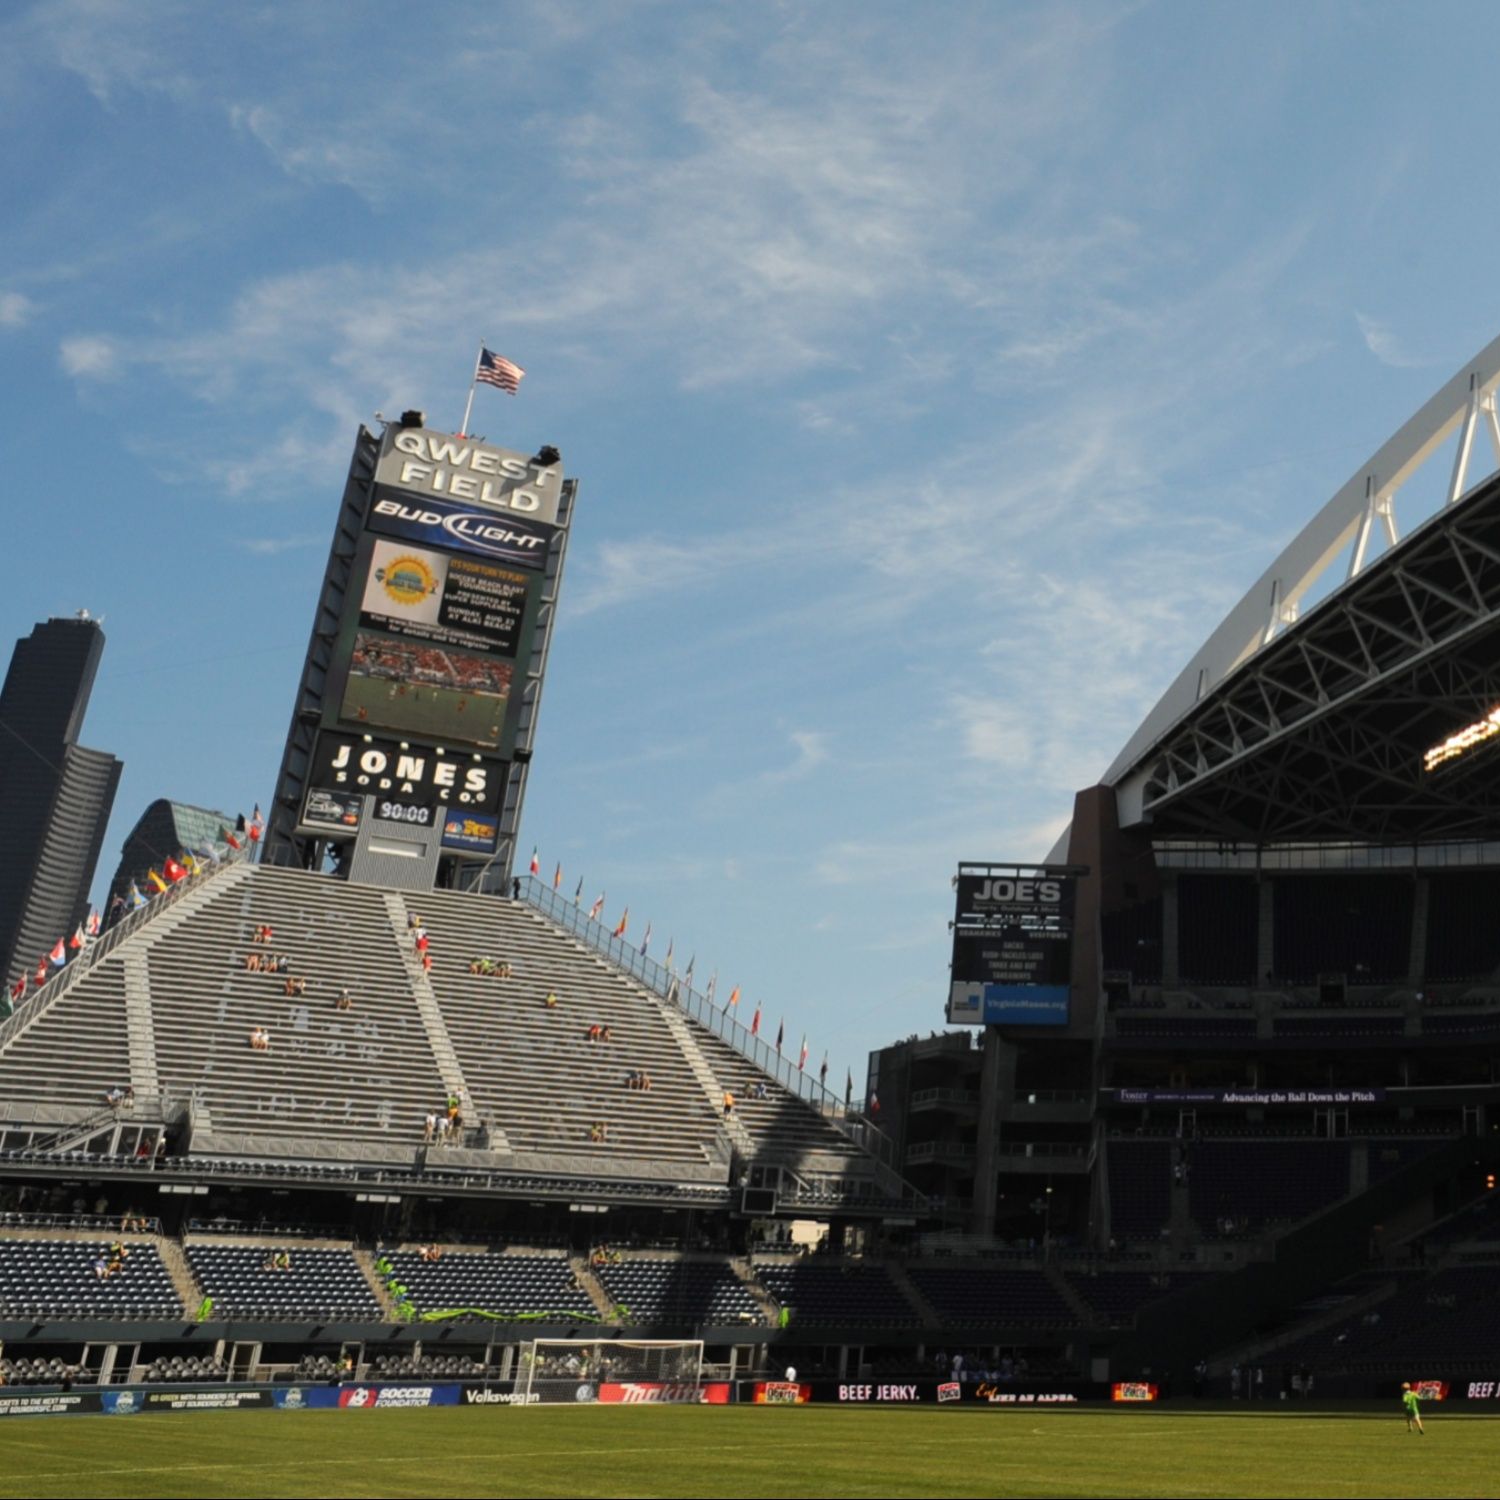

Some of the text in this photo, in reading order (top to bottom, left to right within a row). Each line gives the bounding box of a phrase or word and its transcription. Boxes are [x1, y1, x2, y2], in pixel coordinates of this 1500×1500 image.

[394, 432, 557, 487] QWEST
[400, 461, 540, 512] FIELD
[374, 500, 545, 549] BUD LIGHT
[331, 745, 487, 791] JONES
[336, 771, 413, 793] SODA
[380, 802, 429, 823] 90:00
[972, 879, 1061, 902] JOE'S
[1223, 1092, 1375, 1104] Advancing the Ball Down the Pitch
[378, 1387, 433, 1399] SOCCER
[839, 1384, 920, 1400] BEEF JERKY.
[1467, 1382, 1495, 1398] BEEF
[374, 1398, 430, 1407] FOUNDATION
